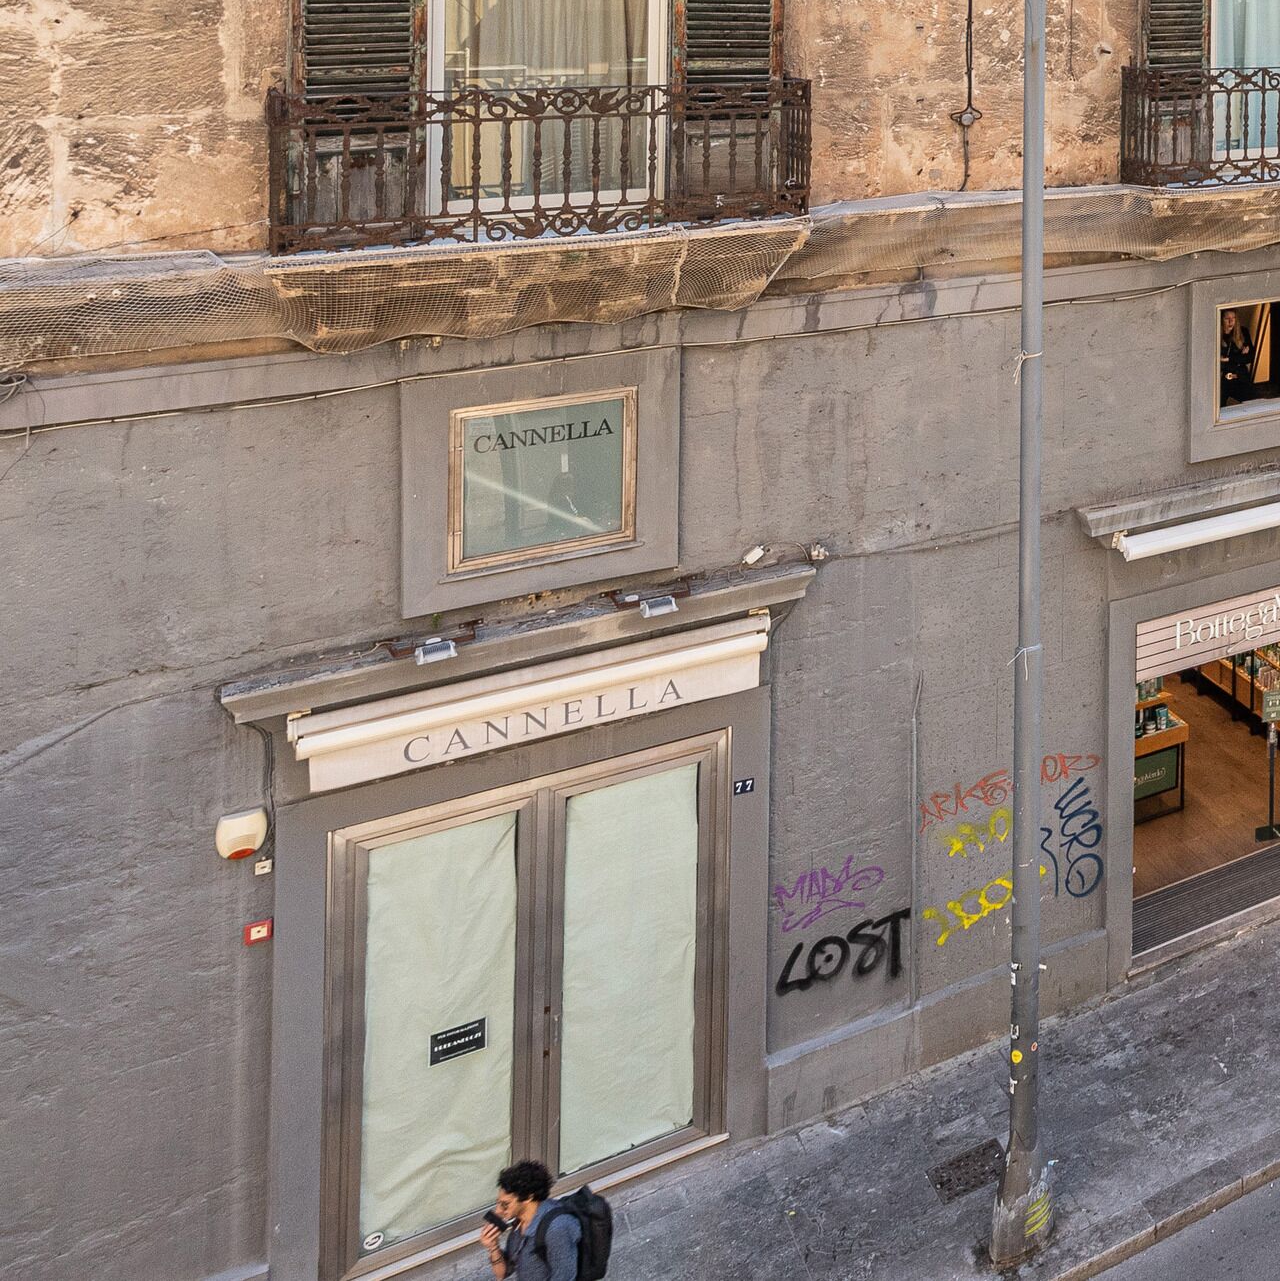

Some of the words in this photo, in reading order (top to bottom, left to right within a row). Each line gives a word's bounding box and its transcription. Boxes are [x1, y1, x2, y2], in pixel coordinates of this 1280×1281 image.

[473, 418, 614, 454] CANNELLA
[403, 679, 684, 763] CANNELLA
[735, 780, 753, 793] 77
[776, 907, 911, 996] LOST
